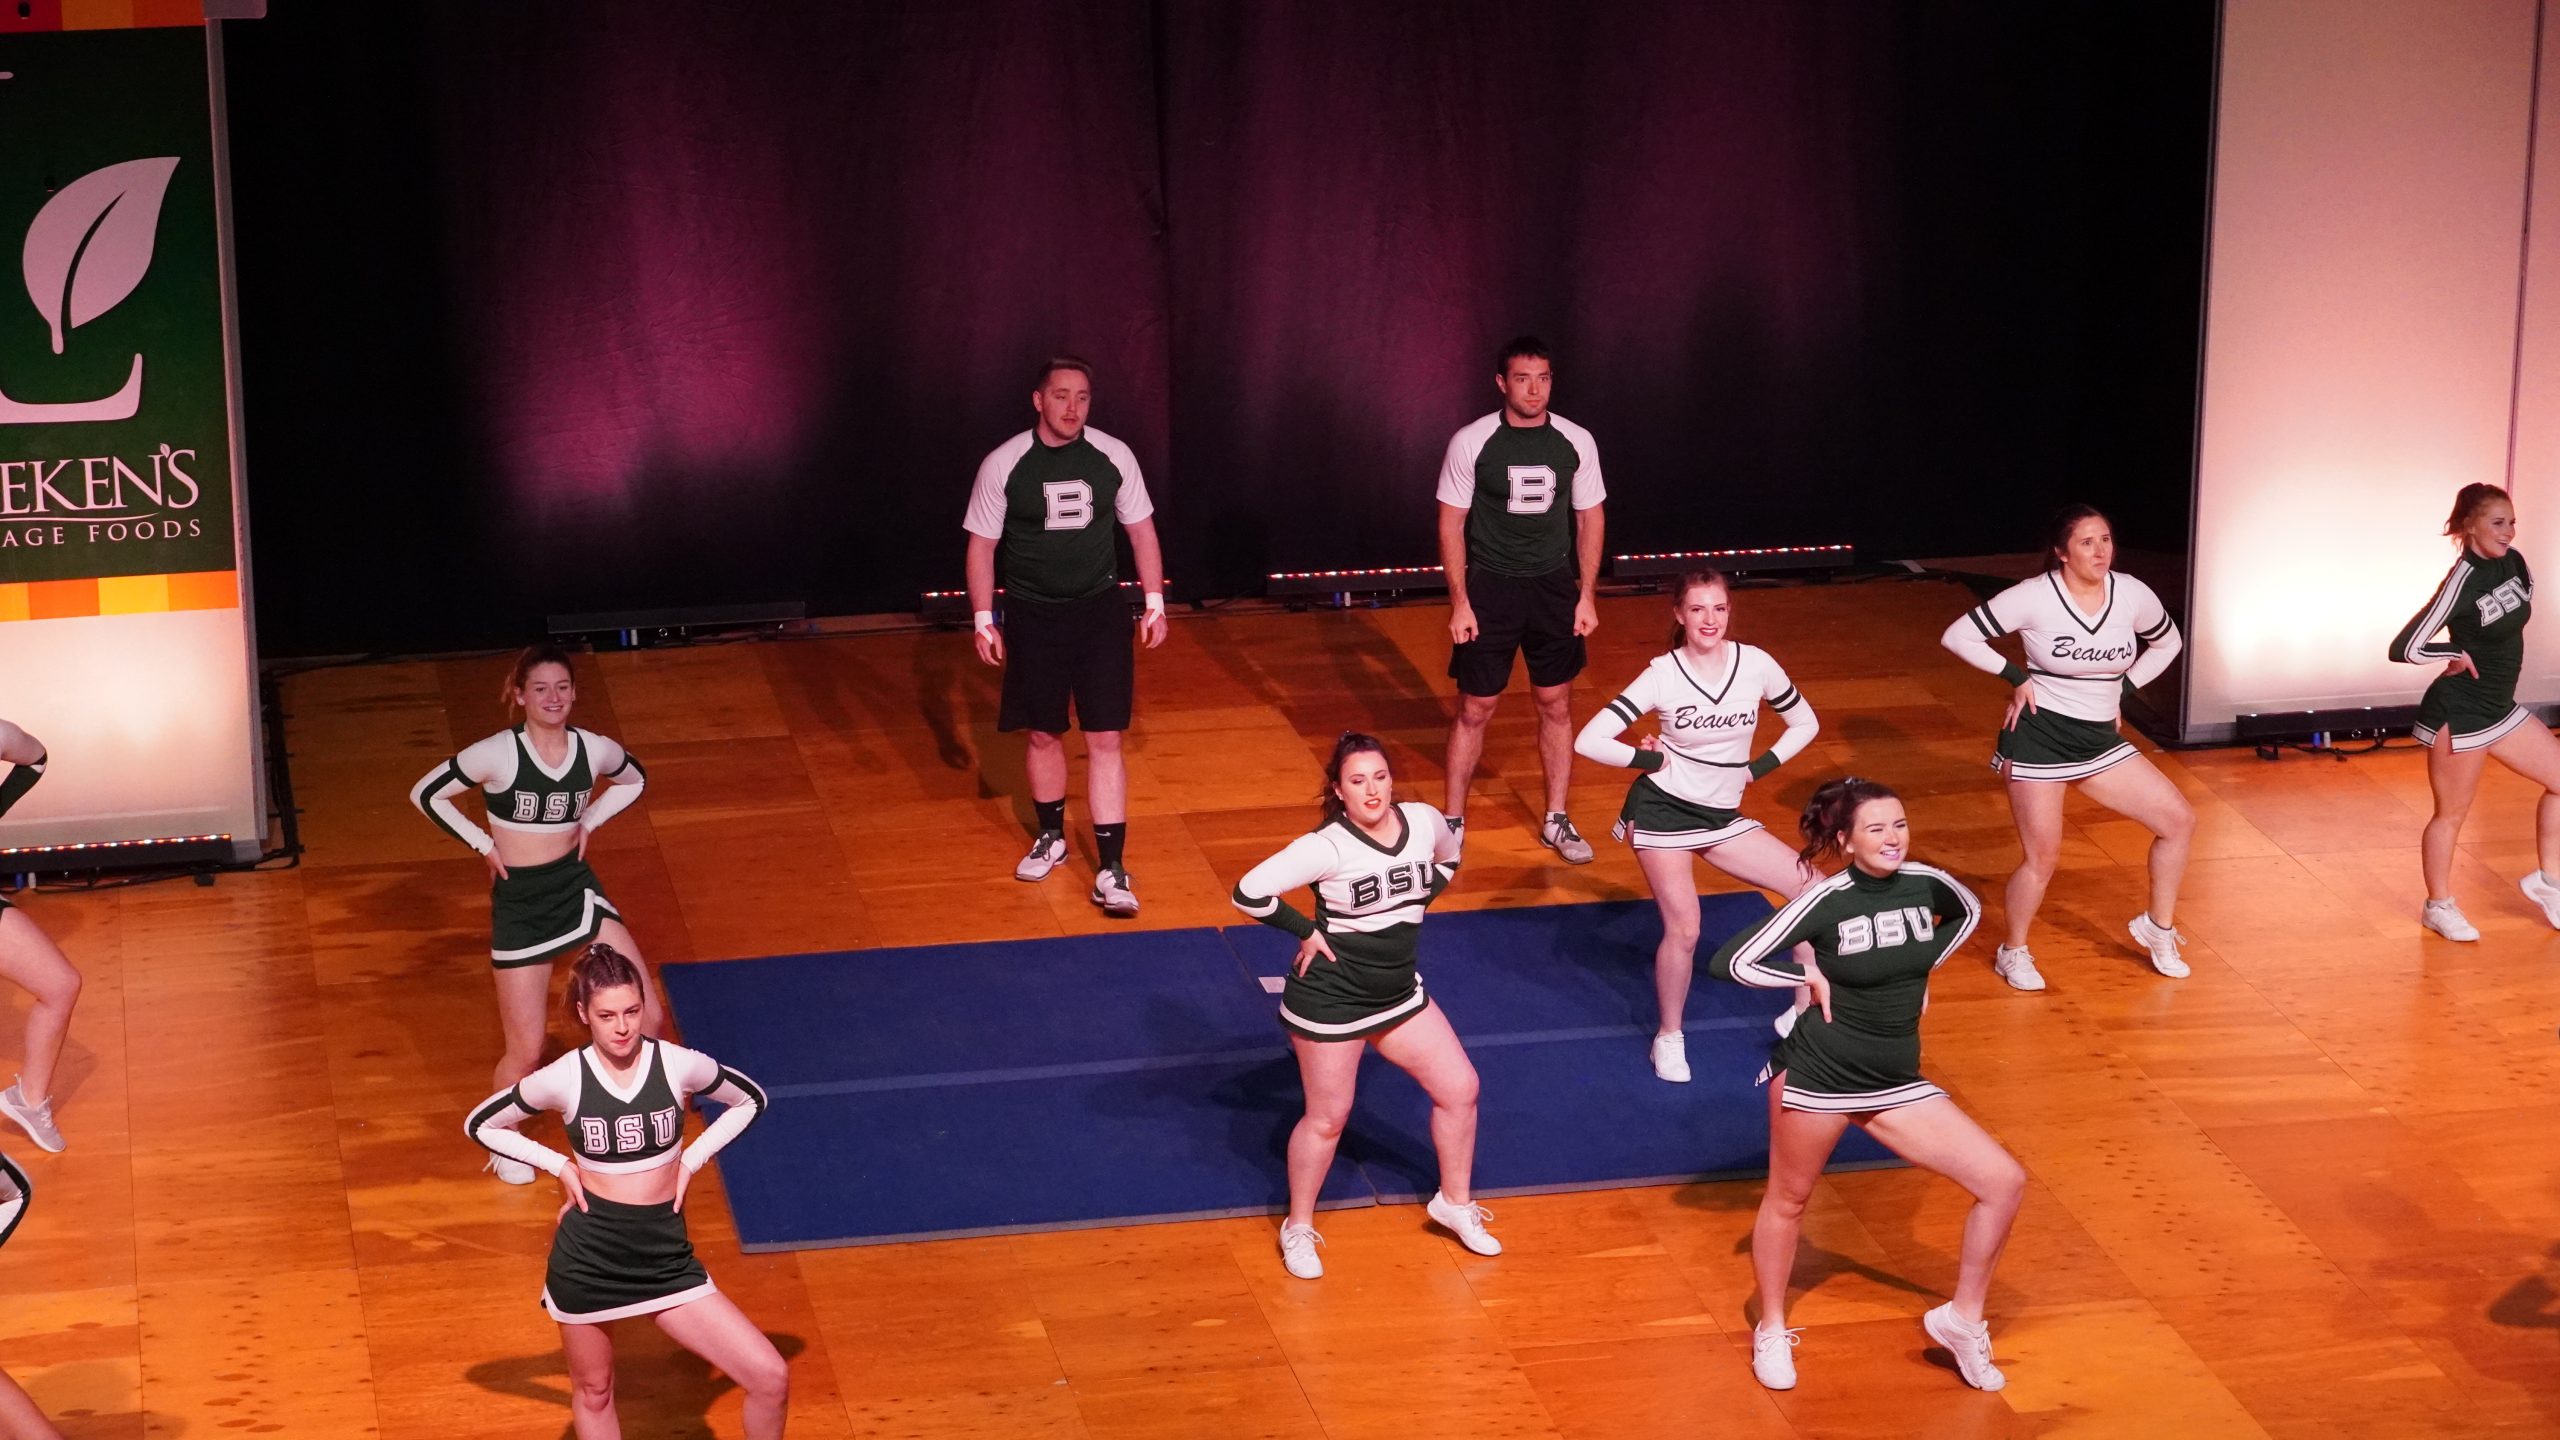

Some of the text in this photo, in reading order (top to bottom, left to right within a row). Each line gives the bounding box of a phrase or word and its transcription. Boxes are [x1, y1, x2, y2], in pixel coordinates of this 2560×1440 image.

[1043, 479, 1093, 530] B
[1507, 465, 1556, 514] B
[1, 519, 201, 548] AGE FOODS
[2051, 636, 2133, 661] Beavers
[1674, 705, 1757, 729] Beavers
[1837, 905, 1935, 956] BSU
[580, 1105, 676, 1155] BSU
